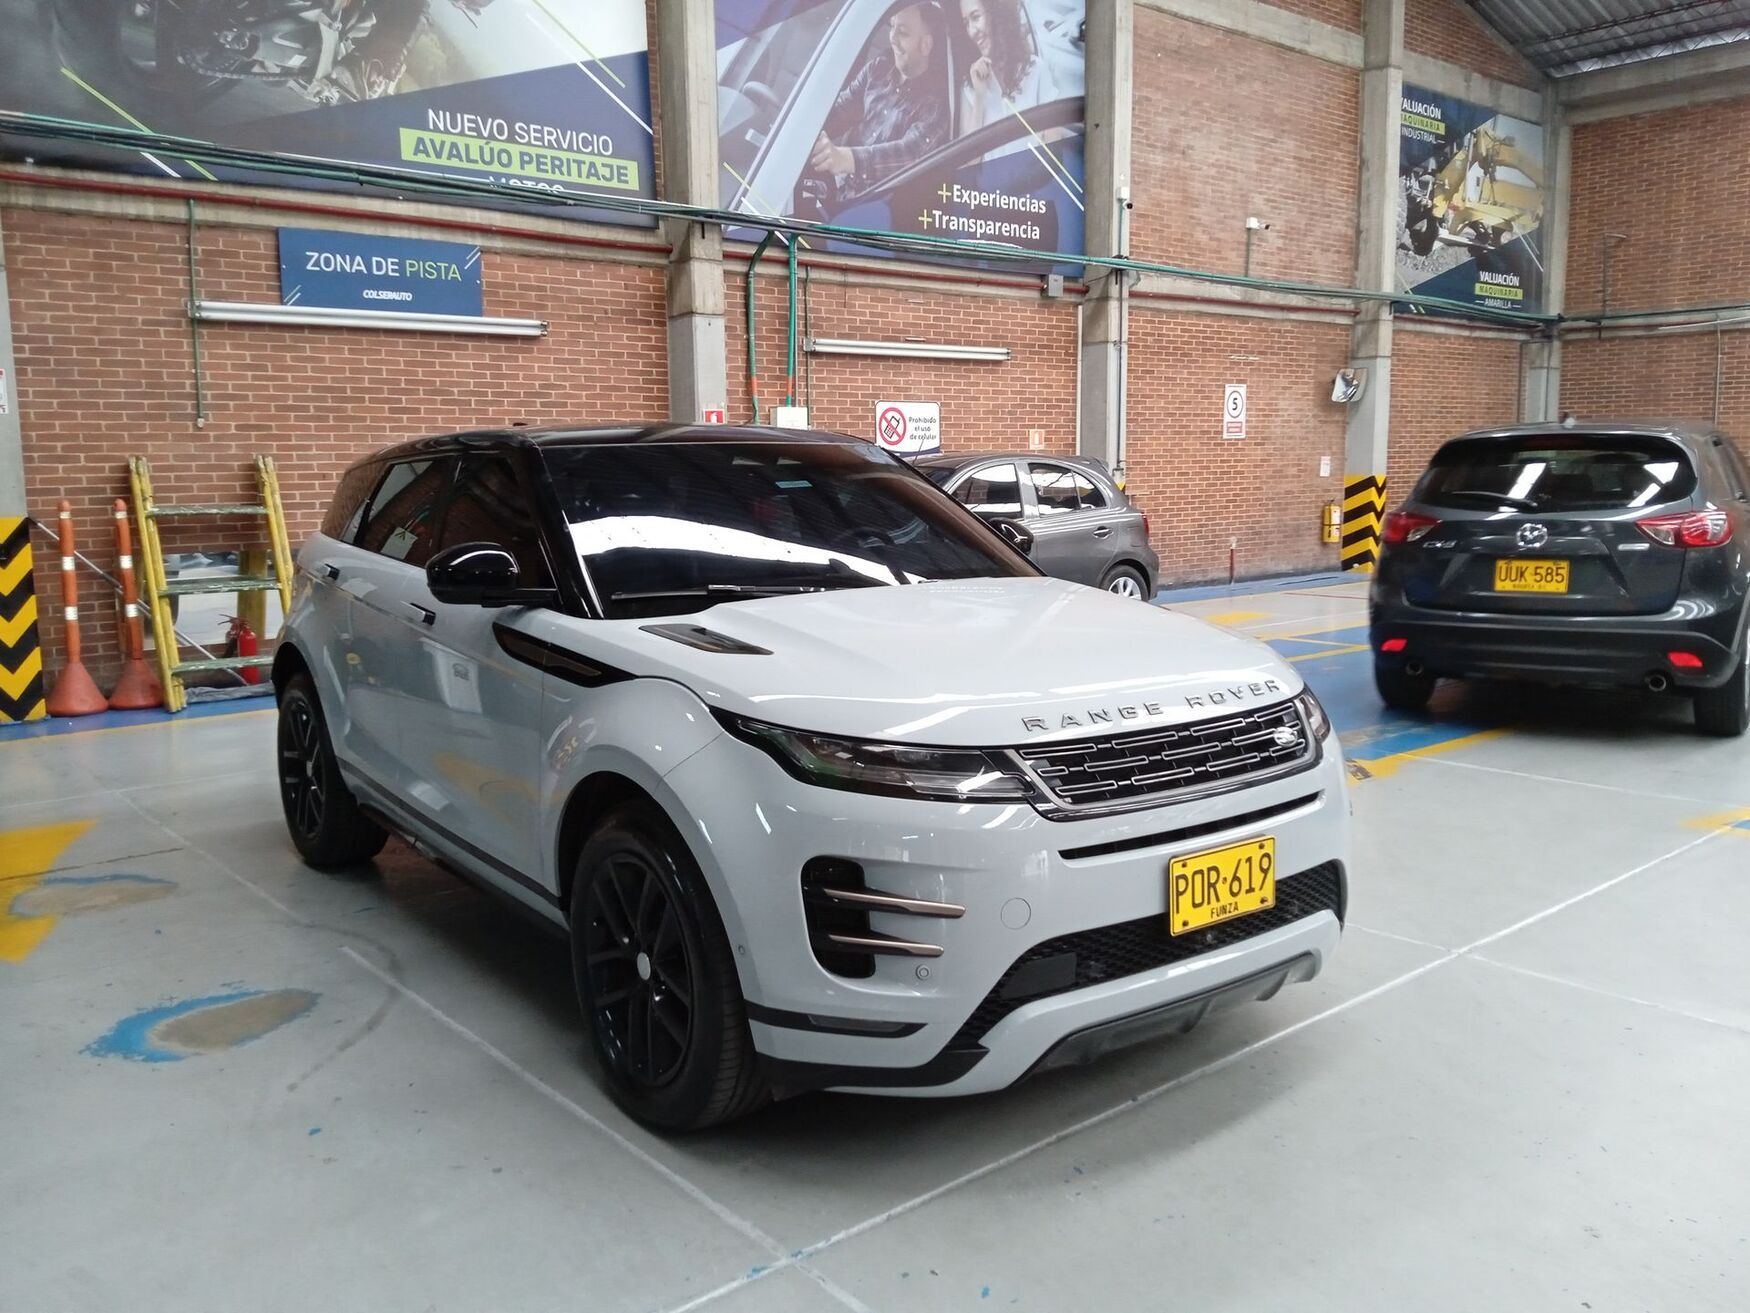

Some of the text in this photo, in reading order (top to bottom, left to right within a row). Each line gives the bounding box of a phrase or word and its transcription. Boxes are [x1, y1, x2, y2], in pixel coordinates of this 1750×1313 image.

[1401, 97, 1441, 119] ALUACIÓN
[428, 108, 613, 155] NUEVO SERVICIO
[413, 136, 629, 184] AVALÚO PERITAJE
[305, 251, 462, 281] ZONA DE PISTA
[1480, 271, 1520, 286] VALUACIÓN
[1232, 397, 1238, 411] 5
[908, 416, 937, 424] Prohibido
[918, 433, 937, 441] celular
[1499, 565, 1565, 584] UUK 585
[1021, 678, 1282, 732] RANGE ROVER
[1210, 901, 1239, 919] FUNZA
